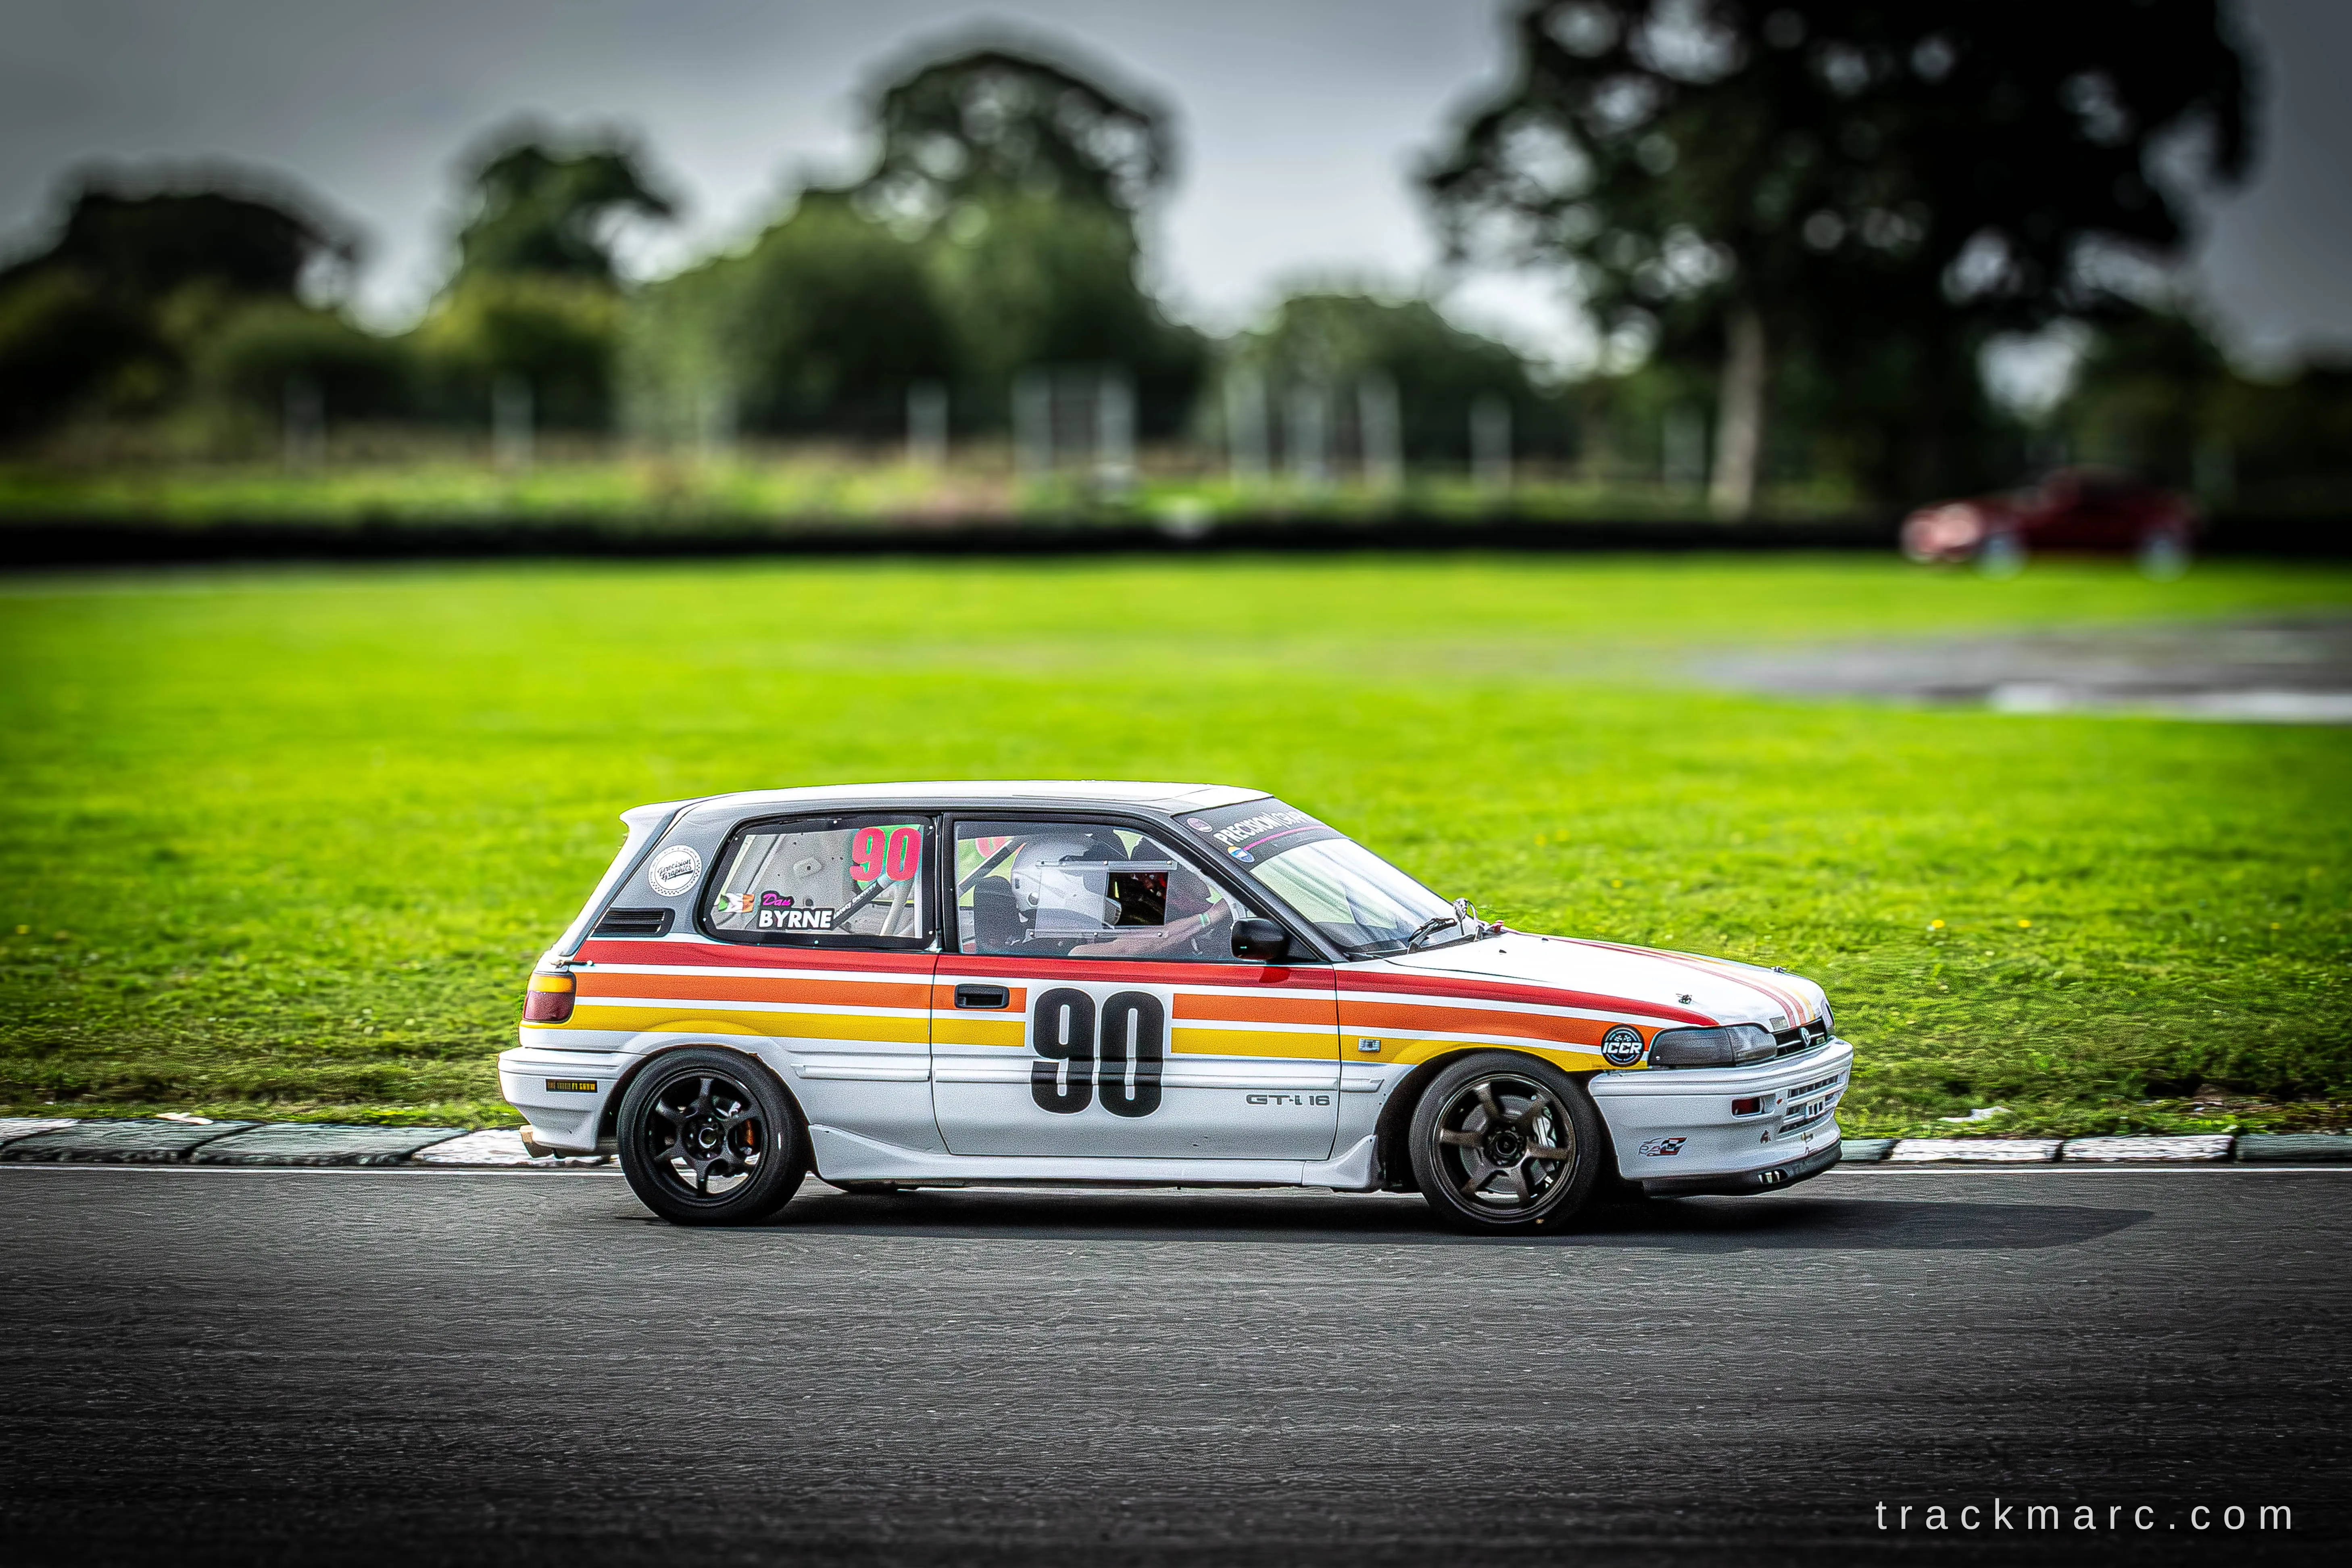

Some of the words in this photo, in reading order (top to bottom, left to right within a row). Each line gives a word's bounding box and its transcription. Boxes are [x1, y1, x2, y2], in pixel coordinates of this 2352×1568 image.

[849, 827, 922, 882] 90
[763, 893, 791, 906] Dan
[759, 910, 832, 928] BYRNE
[1031, 987, 1164, 1118] 90
[1602, 1043, 1642, 1053] ICCR
[1309, 1095, 1330, 1106] 16
